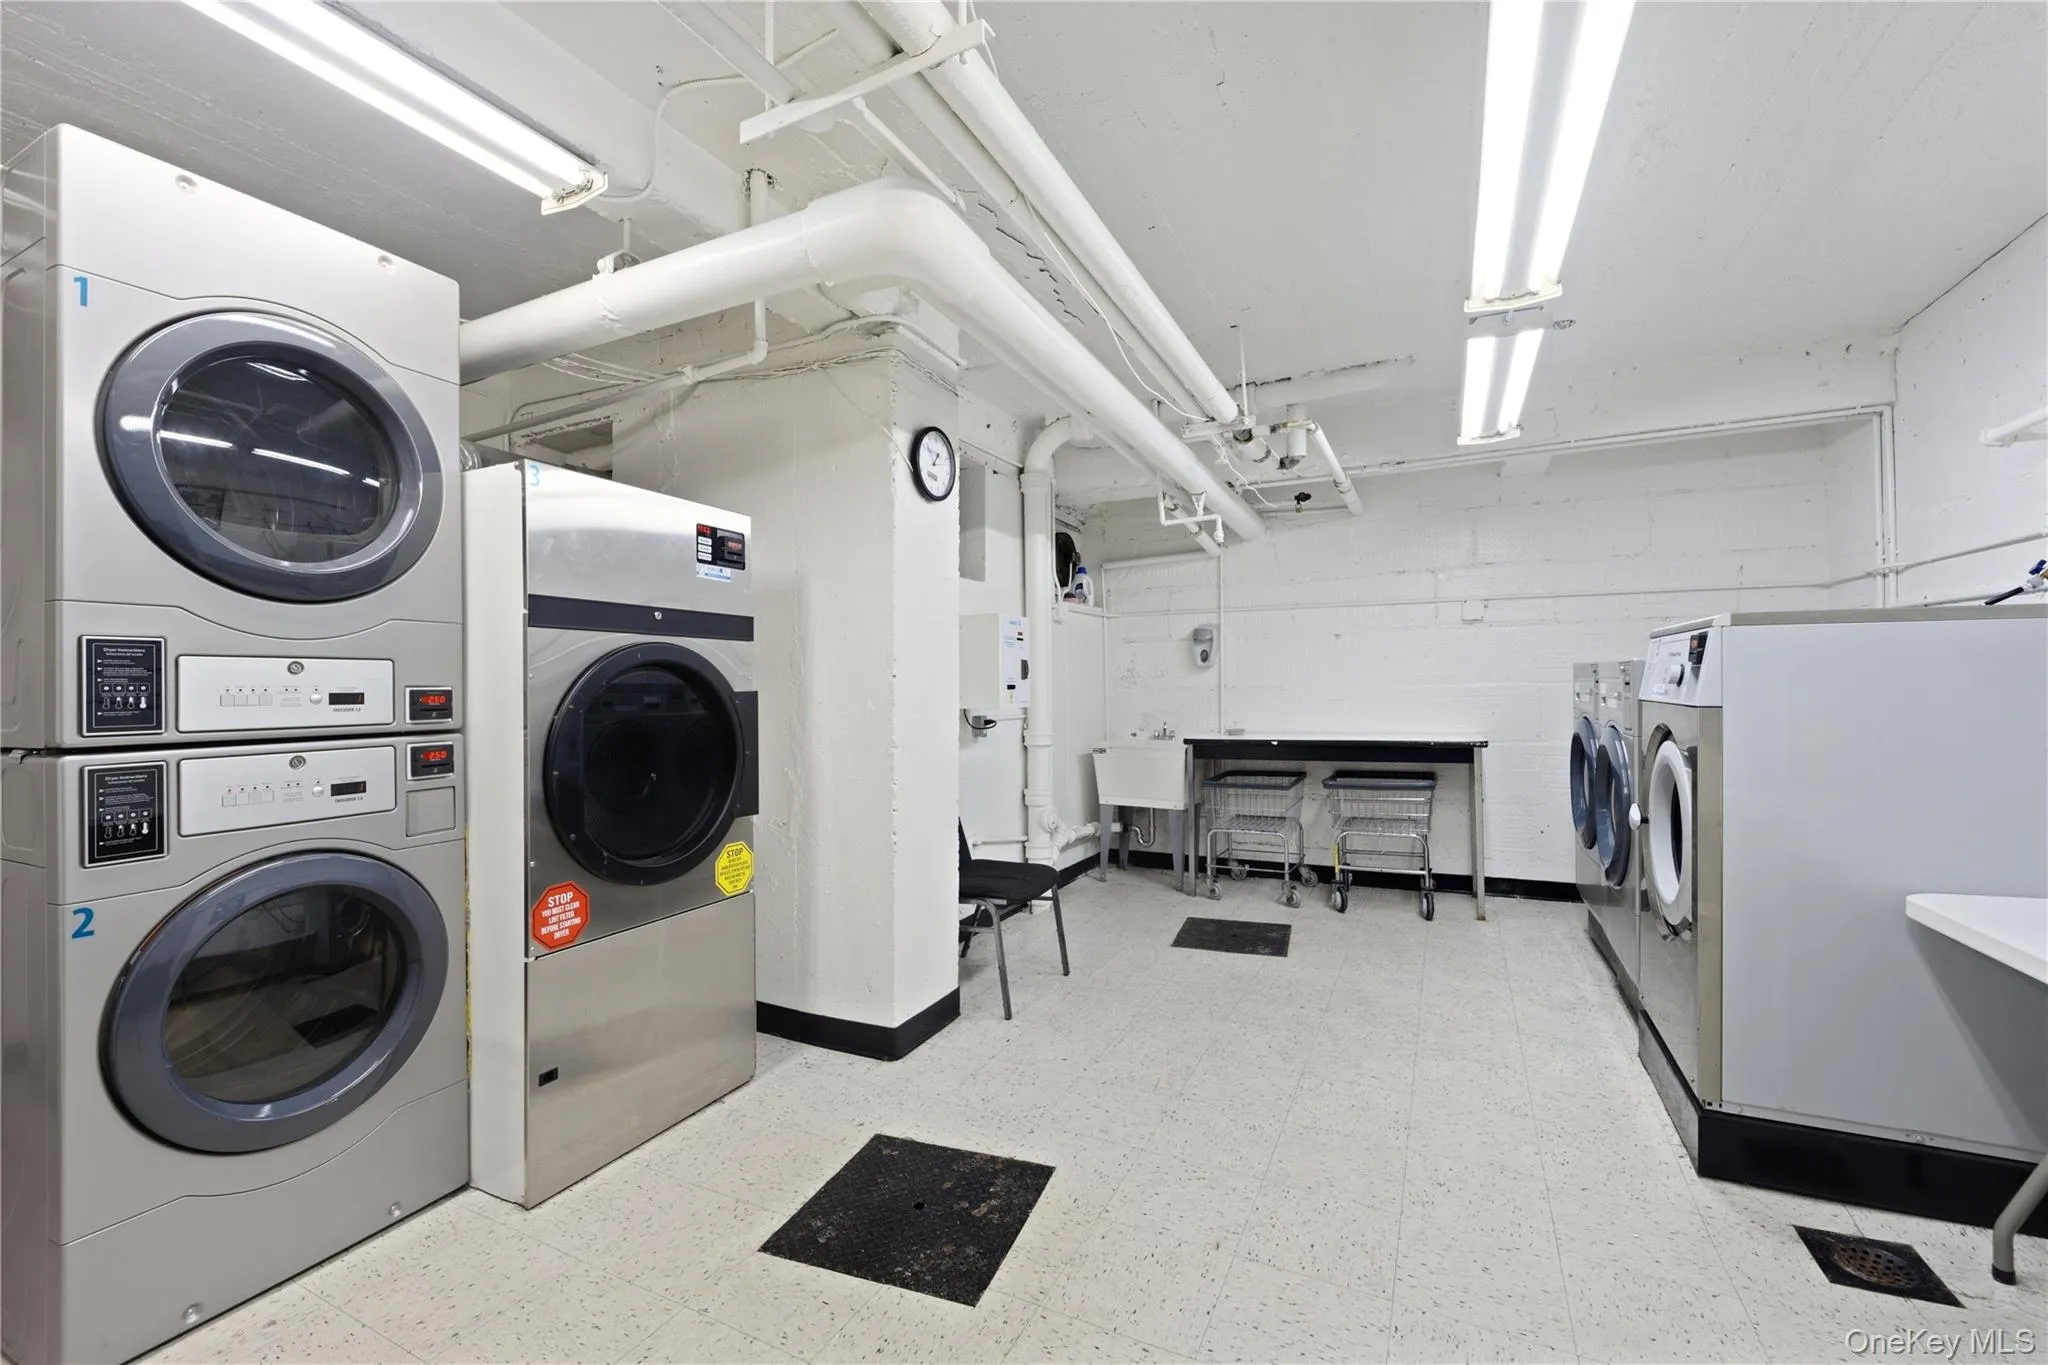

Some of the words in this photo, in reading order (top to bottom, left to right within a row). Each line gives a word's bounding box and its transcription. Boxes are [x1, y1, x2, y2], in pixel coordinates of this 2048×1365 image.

[73, 276, 88, 307] 1
[529, 464, 540, 486] 3
[726, 847, 743, 858] STOP
[548, 891, 573, 907] STOP
[541, 908, 551, 917] YOU
[551, 905, 564, 915] MUST
[565, 901, 580, 911] CLEAN
[549, 915, 559, 924] LINT
[559, 910, 575, 921] FILTER
[72, 907, 94, 939] 2
[541, 923, 559, 935] BEFORE
[559, 917, 581, 929] STARTING
[553, 928, 569, 939] DRYER
